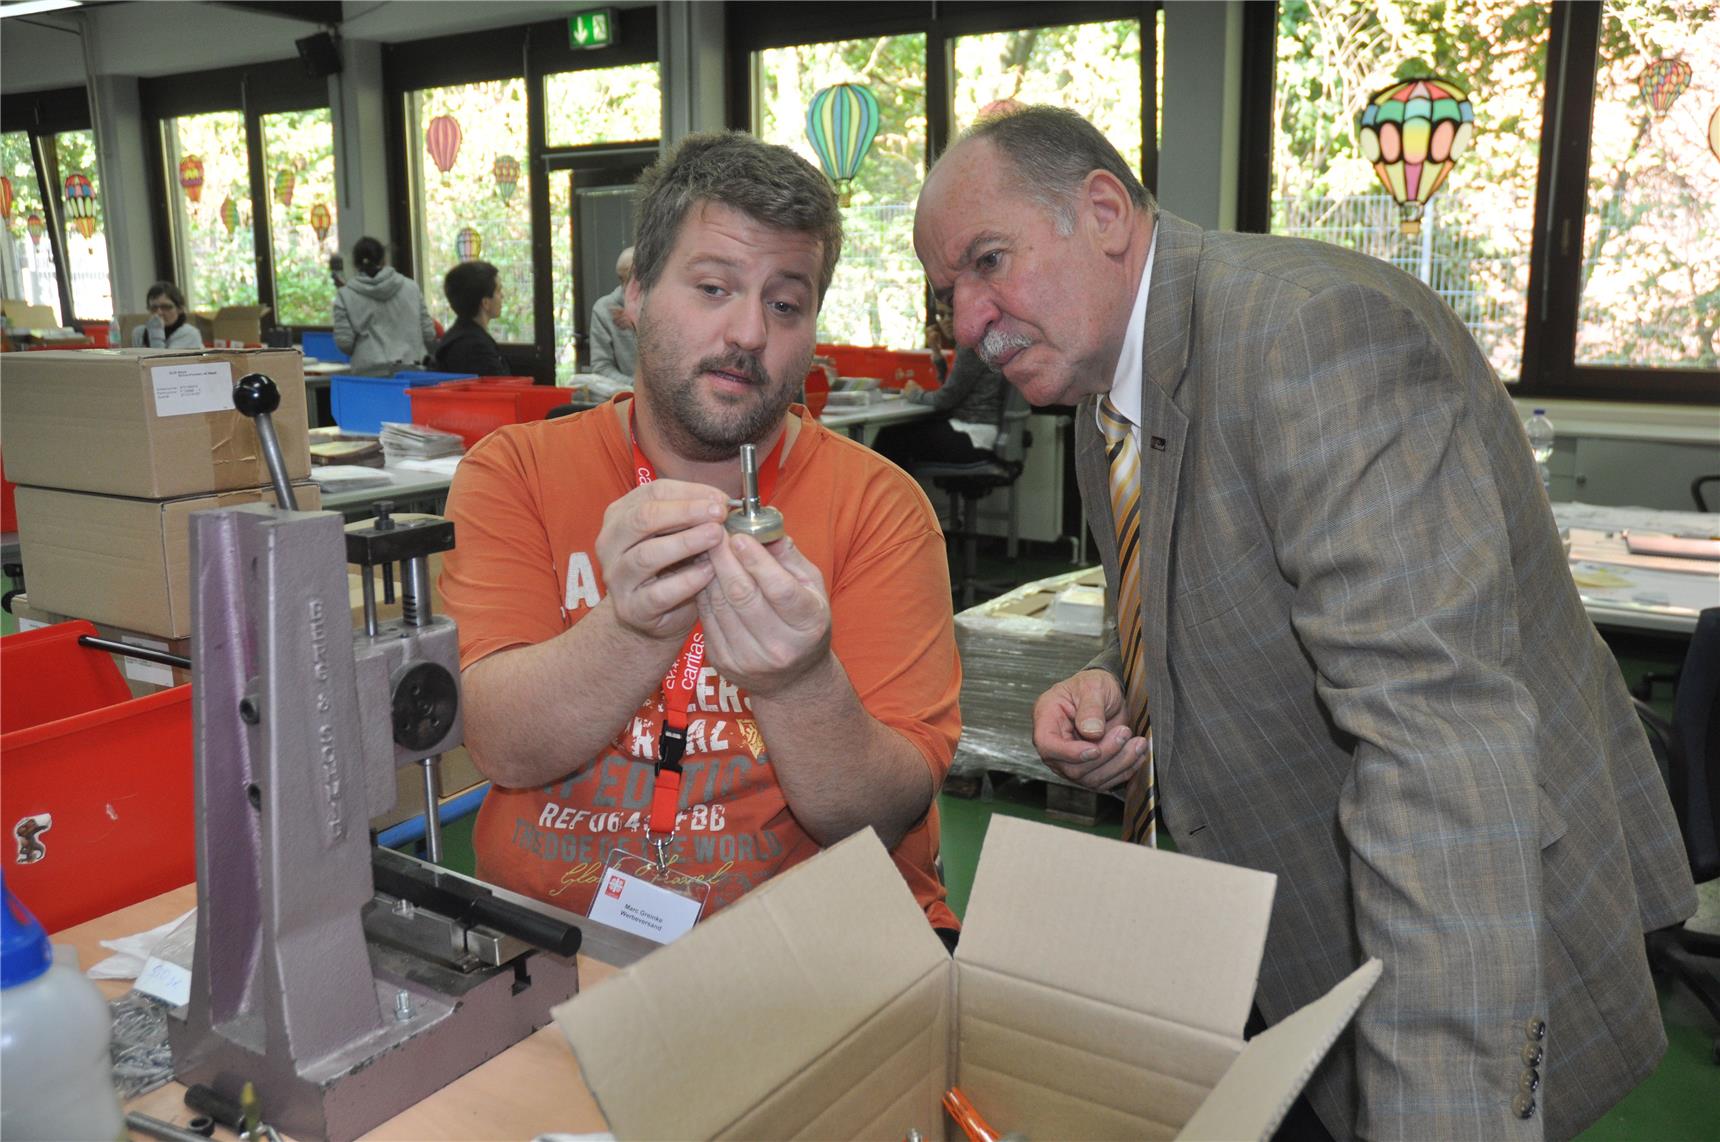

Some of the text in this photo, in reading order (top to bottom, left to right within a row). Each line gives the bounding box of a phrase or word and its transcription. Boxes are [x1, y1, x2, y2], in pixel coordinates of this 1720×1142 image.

[637, 467, 652, 486] ca
[681, 632, 705, 690] caritas
[631, 716, 729, 760] RAL
[693, 831, 784, 864] WORLD
[619, 910, 663, 932] Werbeversand
[624, 903, 640, 915] Marc
